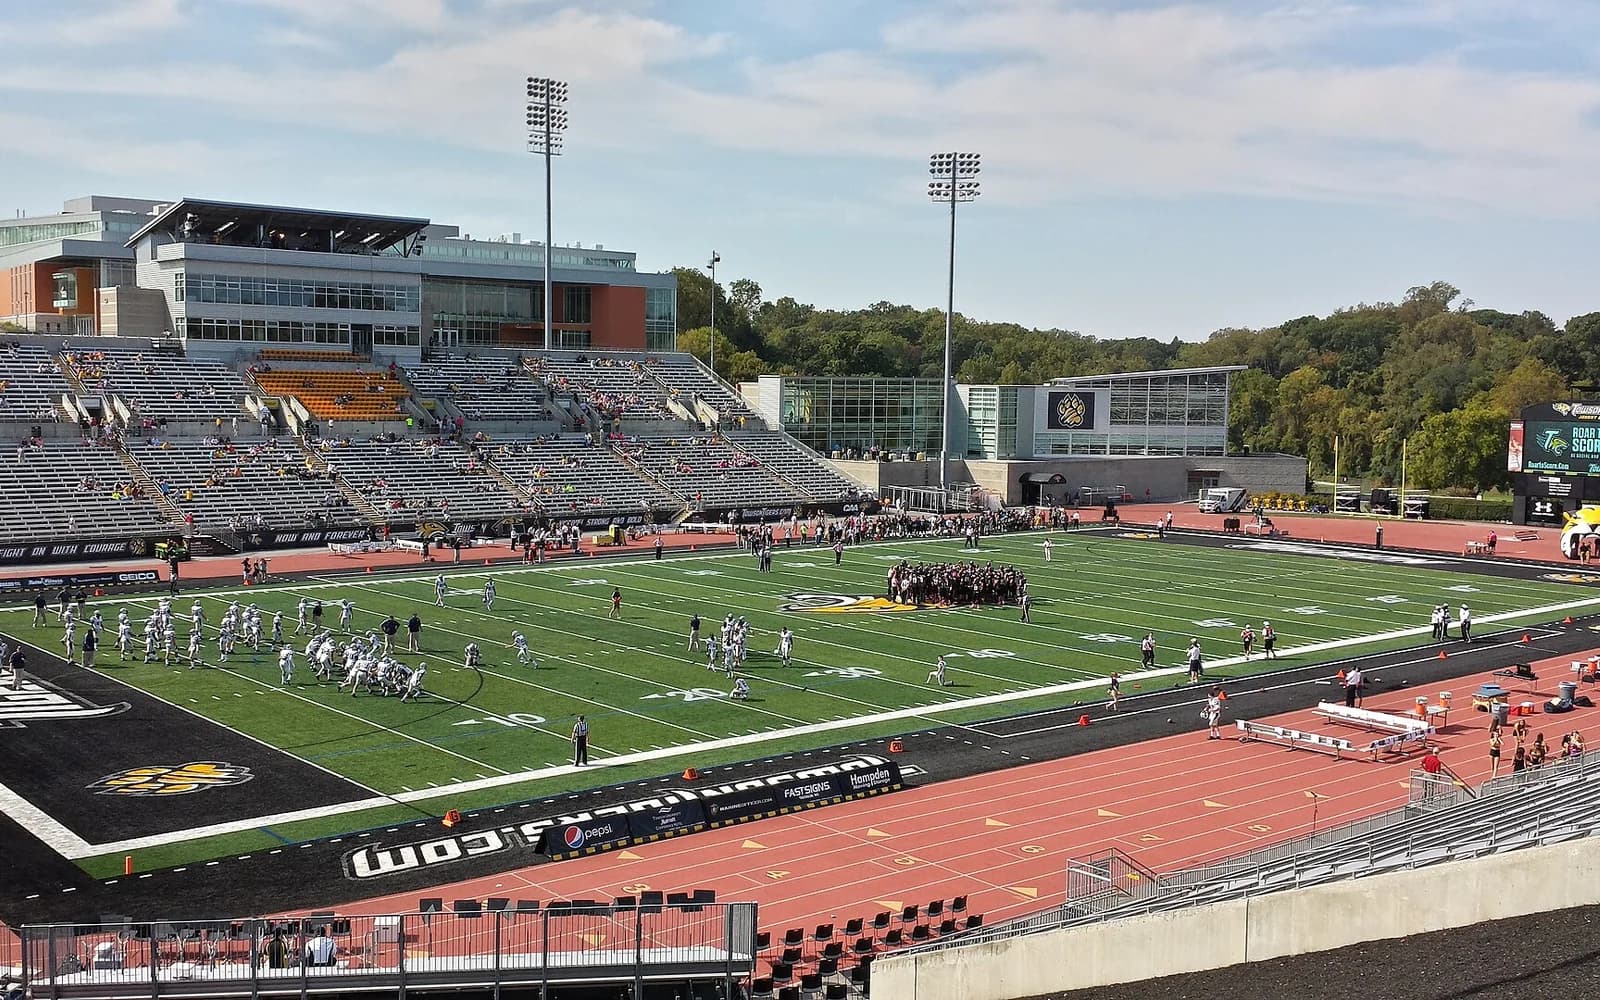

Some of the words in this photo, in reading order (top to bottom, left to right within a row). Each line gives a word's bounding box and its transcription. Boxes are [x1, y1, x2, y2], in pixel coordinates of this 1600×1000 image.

[1572, 427, 1596, 439] ROAR
[842, 503, 859, 512] CAA
[627, 515, 643, 524] BOLD
[453, 522, 487, 534] TOWSN
[274, 533, 299, 543] NOW
[301, 532, 321, 542] AND
[324, 530, 366, 540] FOREVER
[32, 547, 47, 556] ON
[51, 544, 78, 555] WITH
[83, 542, 127, 554] COURAGE
[119, 572, 156, 582] GEICO
[665, 687, 729, 702] 20
[482, 711, 546, 728] 10
[849, 767, 890, 787] Hampden
[784, 780, 831, 799] FASTSIGNS
[584, 823, 614, 841] pepsi
